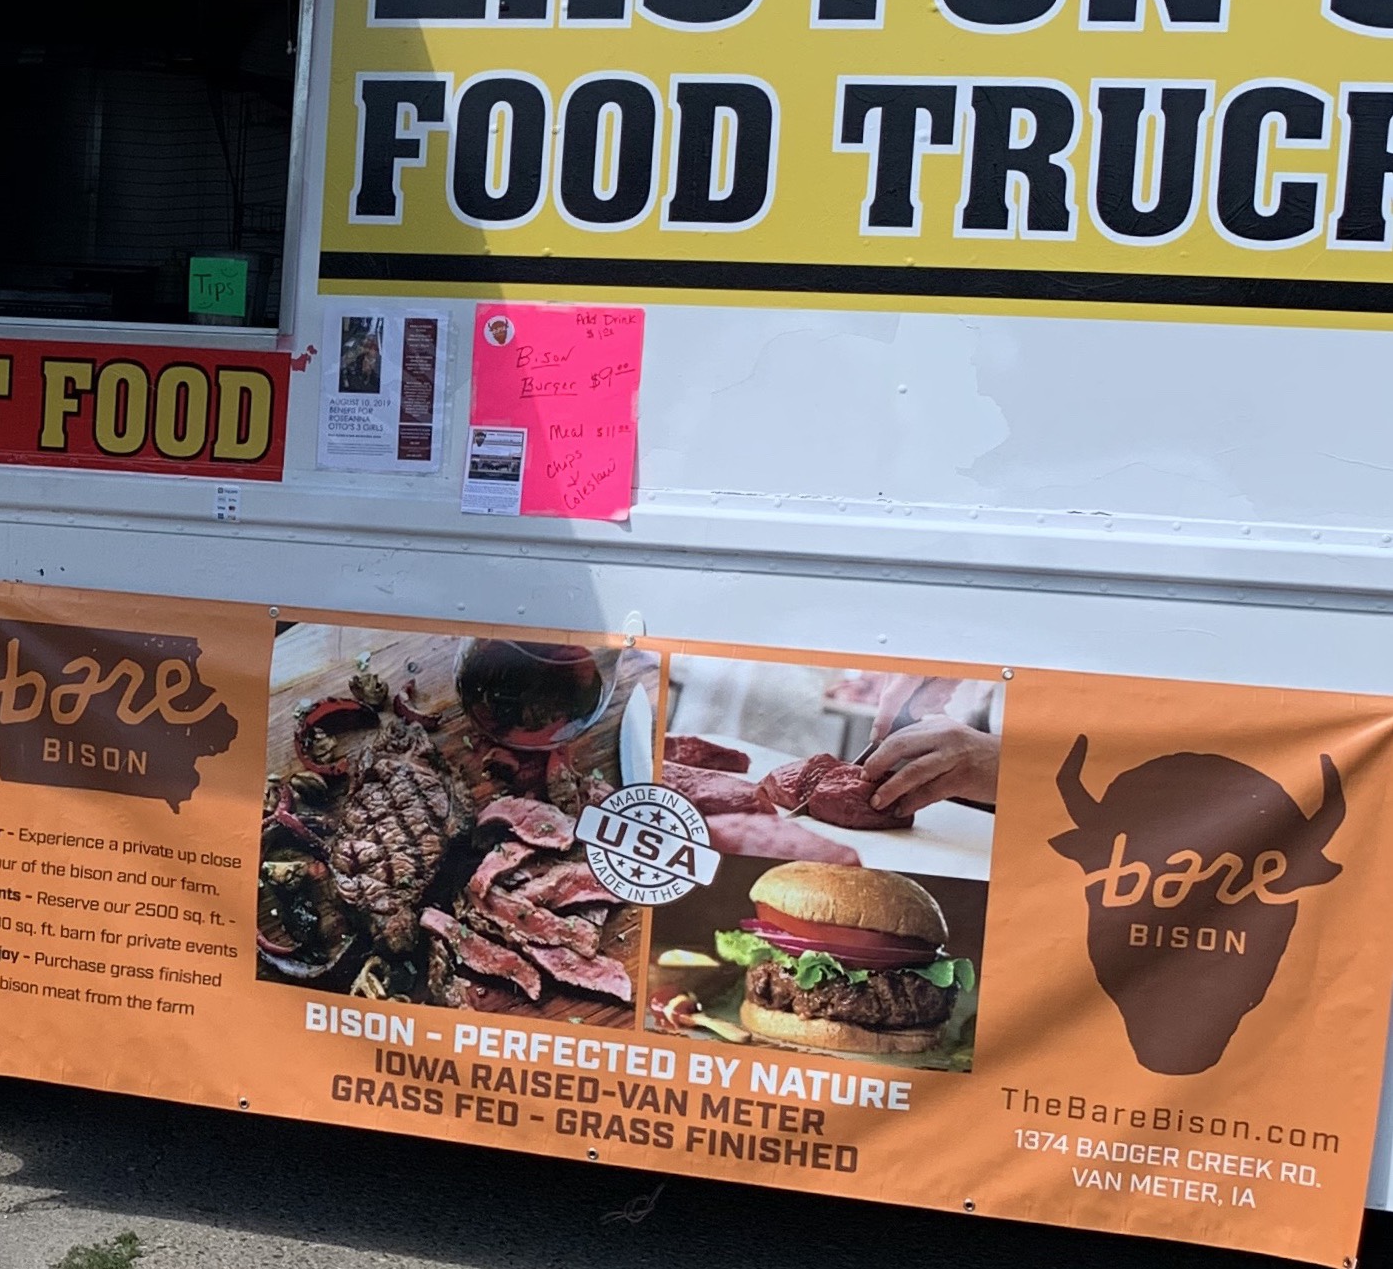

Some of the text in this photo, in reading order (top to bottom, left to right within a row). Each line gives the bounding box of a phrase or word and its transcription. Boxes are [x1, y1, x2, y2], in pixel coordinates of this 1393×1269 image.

[348, 70, 780, 233] FOOD
[40, 357, 274, 463] FOOD
[329, 398, 358, 407] AUGUST
[373, 400, 391, 408] 2019
[358, 407, 373, 415] FOR
[363, 424, 383, 432] GIRLS
[43, 738, 148, 774] BISON
[610, 788, 704, 836] MADE IN THE
[18, 828, 105, 853] Experience
[109, 838, 118, 850] a
[122, 838, 174, 863] private
[177, 847, 197, 865] up
[201, 848, 242, 869] close
[596, 815, 696, 877] USA
[21, 855, 38, 873] of
[41, 858, 66, 876] the
[70, 860, 113, 882] bison
[116, 866, 147, 885] and
[151, 872, 177, 889] our
[180, 874, 220, 897] farm.
[590, 851, 683, 902] MADE IN THE
[1084, 832, 1303, 908] bare
[36, 890, 100, 913] Reserve
[104, 898, 131, 915] our
[134, 901, 179, 920] 2500
[183, 907, 206, 927] sq.
[209, 909, 225, 926] ft.
[15, 919, 38, 937] sq.
[41, 920, 56, 937] ft.
[60, 923, 96, 942] barn
[100, 927, 123, 945] for
[126, 930, 181, 954] private
[185, 937, 238, 958] events
[1130, 923, 1246, 955] BISON
[34, 951, 106, 974] Purchase
[110, 961, 154, 982] grass
[158, 965, 222, 987] finished
[0, 976, 195, 1016] bison meat from the farm
[305, 1001, 414, 1047] BISON
[454, 1024, 676, 1080] PERFECTED
[688, 1053, 739, 1087] BY
[749, 1061, 912, 1111] NATURE
[375, 1048, 825, 1136] IOWA RAISED-VAN METER
[332, 1073, 444, 1115] GRASS
[455, 1092, 518, 1127] FED
[555, 1107, 674, 1149] GRASS
[686, 1126, 858, 1173] FINISHED
[1001, 1087, 1340, 1153] TheBareBison.com
[1014, 1128, 1321, 1188] 1374 BADGER CREEK RD.
[1071, 1165, 1257, 1208] VAN METER, IA
